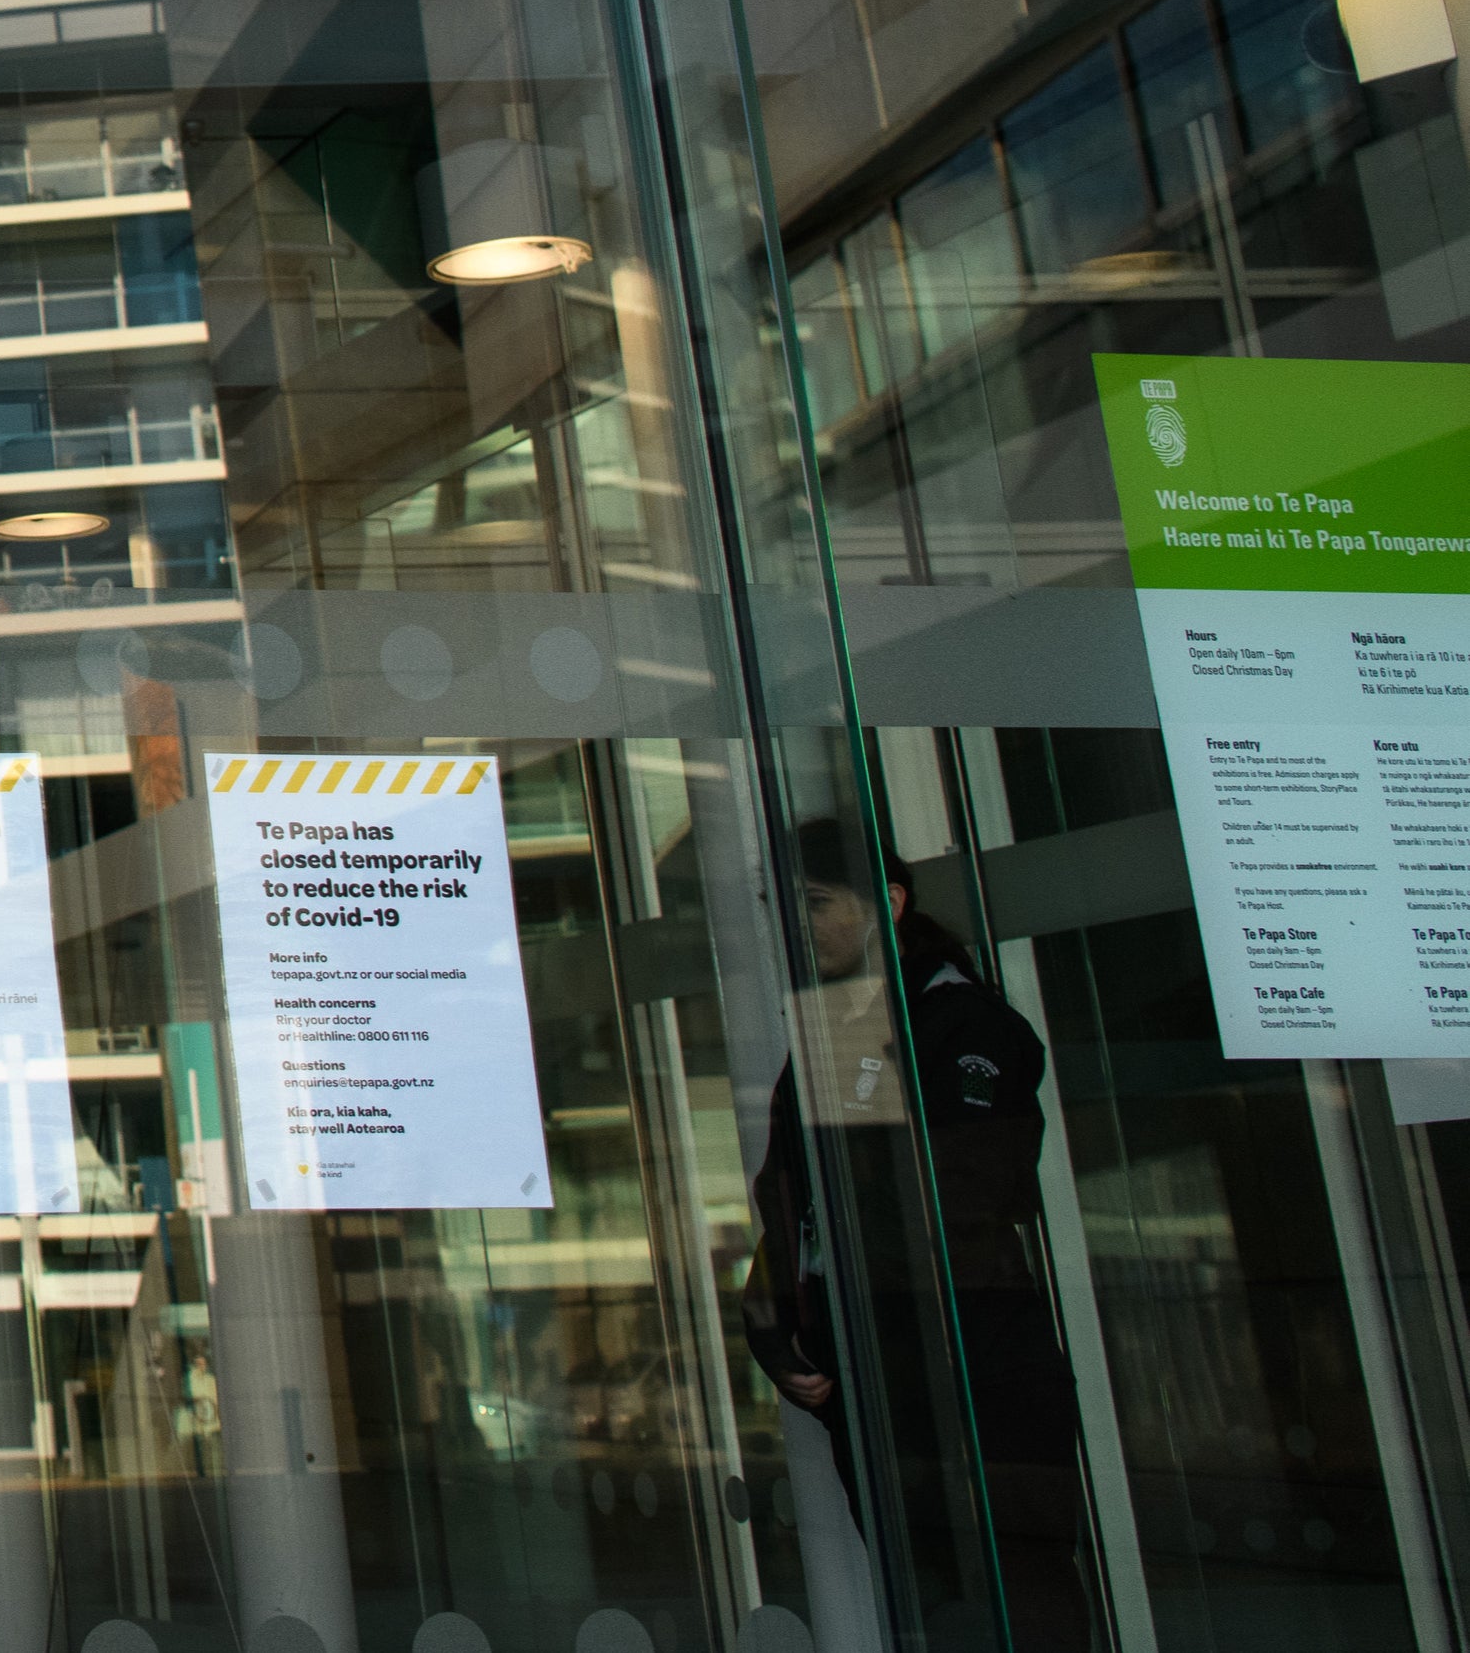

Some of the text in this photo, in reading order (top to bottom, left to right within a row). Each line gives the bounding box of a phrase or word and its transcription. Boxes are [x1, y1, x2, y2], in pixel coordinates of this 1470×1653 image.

[1155, 490, 1353, 518] Welcome to Te Papa
[1163, 527, 1221, 547] Haere
[1227, 529, 1262, 548] mai
[1266, 529, 1286, 548] ki
[1289, 529, 1312, 549] Te
[1317, 530, 1366, 555] Papa
[1185, 630, 1217, 641] Hours
[1351, 632, 1405, 646] Ngā hāora
[1189, 648, 1214, 661] Open
[1216, 648, 1238, 660] daily
[1240, 649, 1265, 658] 10am
[1275, 649, 1295, 661] 6pm
[1192, 664, 1292, 678] Closed Christmas Day
[1362, 683, 1469, 695] Rā Kirihimete kua Katia
[1207, 738, 1260, 752] Free entry
[1374, 740, 1419, 751] Kore utu
[256, 822, 394, 845] Te Papa has
[261, 850, 481, 874] closed temporarily
[263, 878, 467, 898] to reduce the risk
[267, 907, 399, 927] of Covid-19
[1243, 928, 1317, 943] Te Papa Store
[270, 952, 327, 962] More info
[272, 969, 466, 981] tepapa.govt.nz or our social media
[1254, 987, 1324, 1002] Te Papa Cafe
[275, 998, 376, 1009] Health concerns
[276, 1014, 371, 1027] Ring your doctor
[278, 1031, 429, 1042] or Healthline: 0800 611 116
[282, 1060, 345, 1072] Questions
[285, 1077, 434, 1090] enquiries@tepapa.govt.nz
[287, 1106, 391, 1119] Kia ora, kia kaha,
[289, 1123, 405, 1136] stay well Aotearoa
